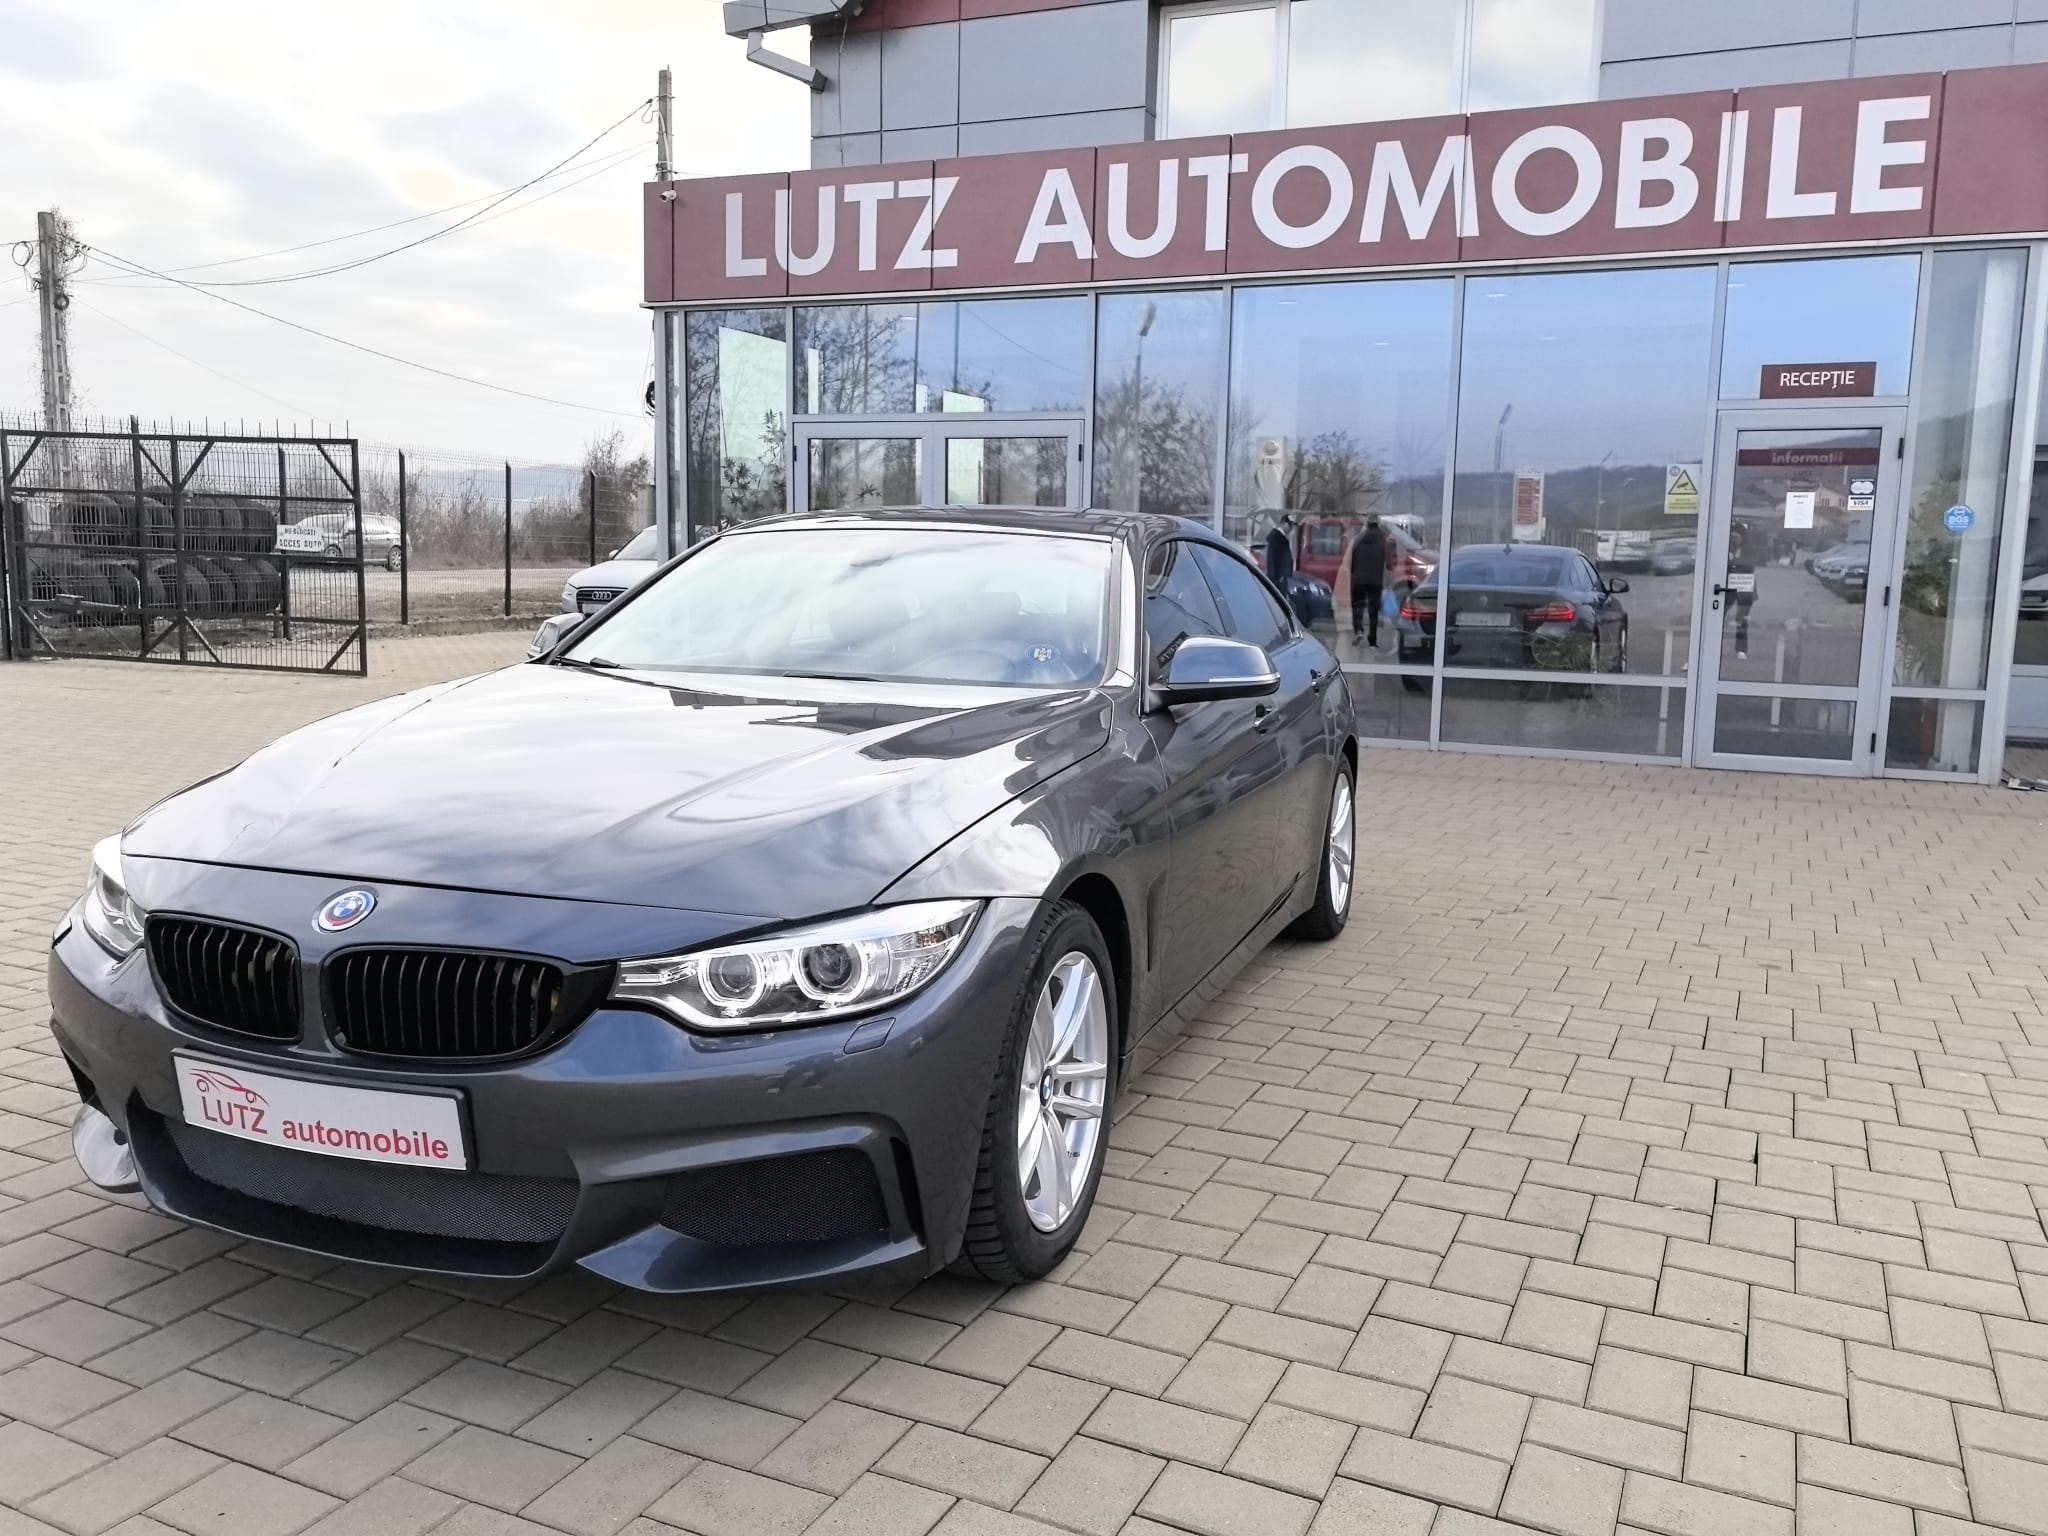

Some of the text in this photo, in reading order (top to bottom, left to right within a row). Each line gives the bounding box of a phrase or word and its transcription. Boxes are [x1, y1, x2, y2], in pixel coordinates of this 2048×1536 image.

[725, 94, 1932, 278] LUTZ AUTOMOBILE
[280, 539, 322, 549] ACCES AUTO
[201, 1096, 449, 1160] LUTZ automobile
